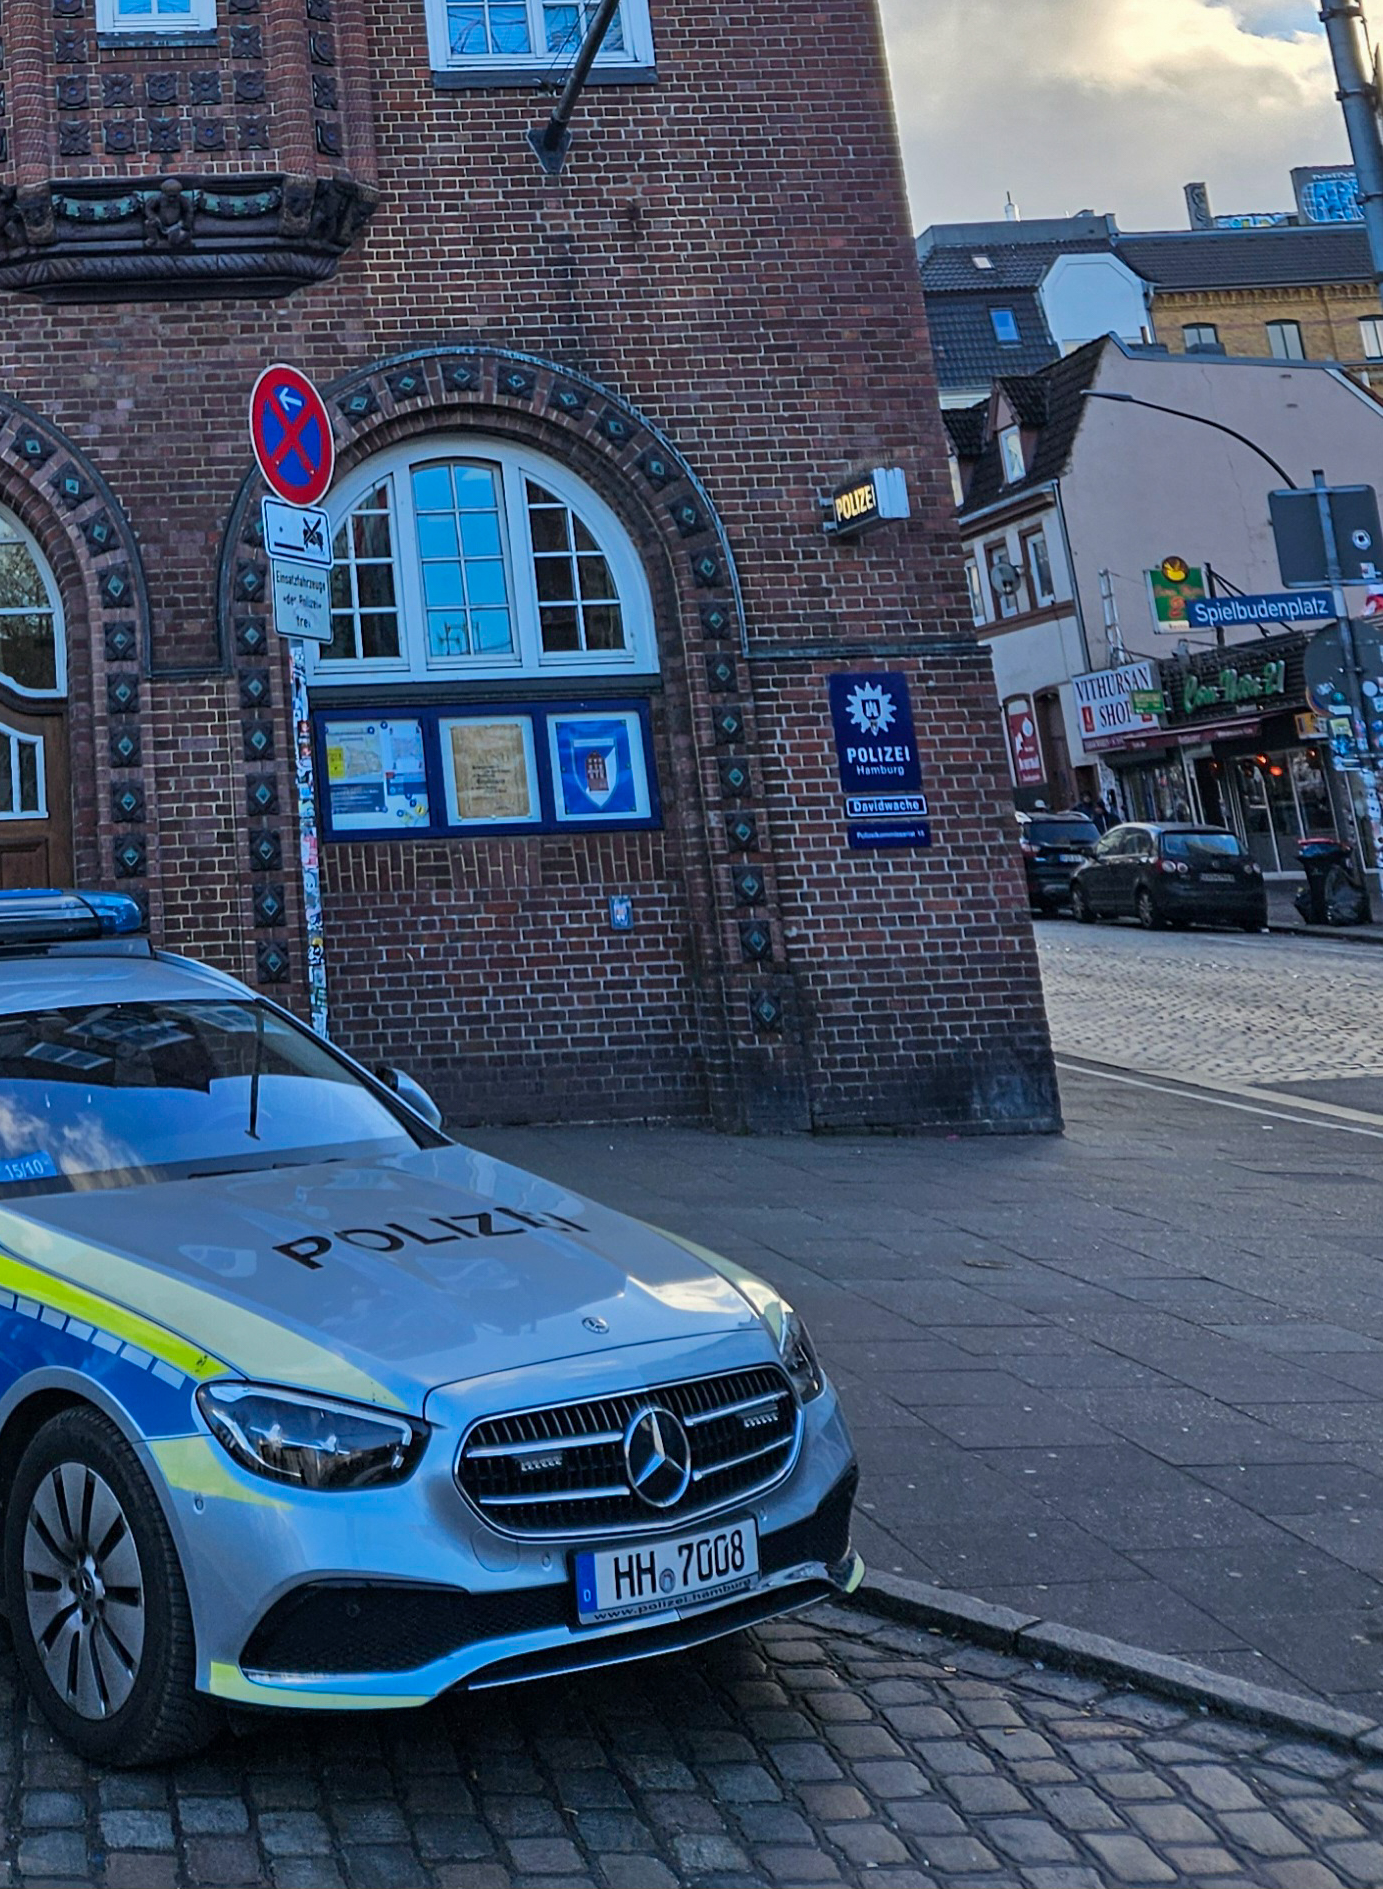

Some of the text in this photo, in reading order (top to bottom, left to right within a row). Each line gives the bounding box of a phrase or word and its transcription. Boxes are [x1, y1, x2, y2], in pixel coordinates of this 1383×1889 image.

[835, 483, 877, 523] POLIZEI
[1196, 596, 1329, 626] Spielbudenplatz
[1075, 666, 1150, 702] VITHURSAN
[847, 745, 911, 763] POLIZEI
[856, 764, 905, 777] Hamburg
[853, 798, 920, 813] Davidwache
[4, 1158, 44, 1179] 15/10
[271, 1206, 592, 1270] POLIZEI
[583, 1529, 745, 1602] D HH 7008
